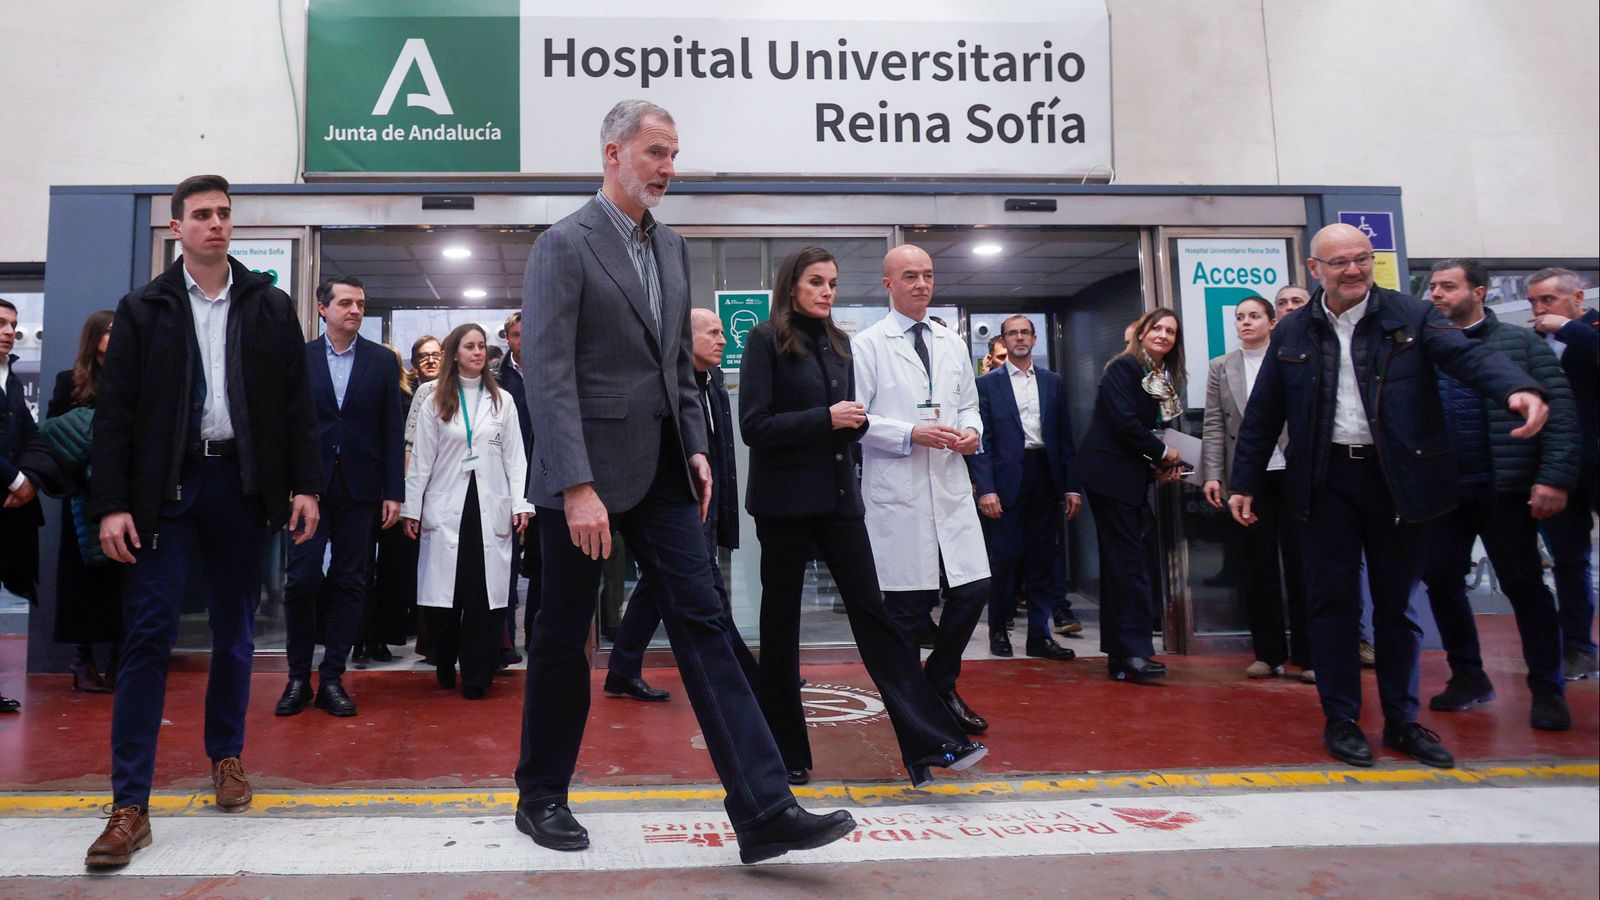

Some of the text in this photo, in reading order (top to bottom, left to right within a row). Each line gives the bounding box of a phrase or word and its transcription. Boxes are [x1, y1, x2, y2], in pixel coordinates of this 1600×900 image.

[544, 35, 1086, 89] Hospital Universitario
[815, 96, 1086, 144] Reina Sofía
[323, 121, 502, 142] Junta de Andalucía
[249, 248, 267, 256] Reina
[1184, 247, 1209, 255] Hospital
[1192, 261, 1277, 285] Acceso
[957, 821, 1119, 838] Regala
